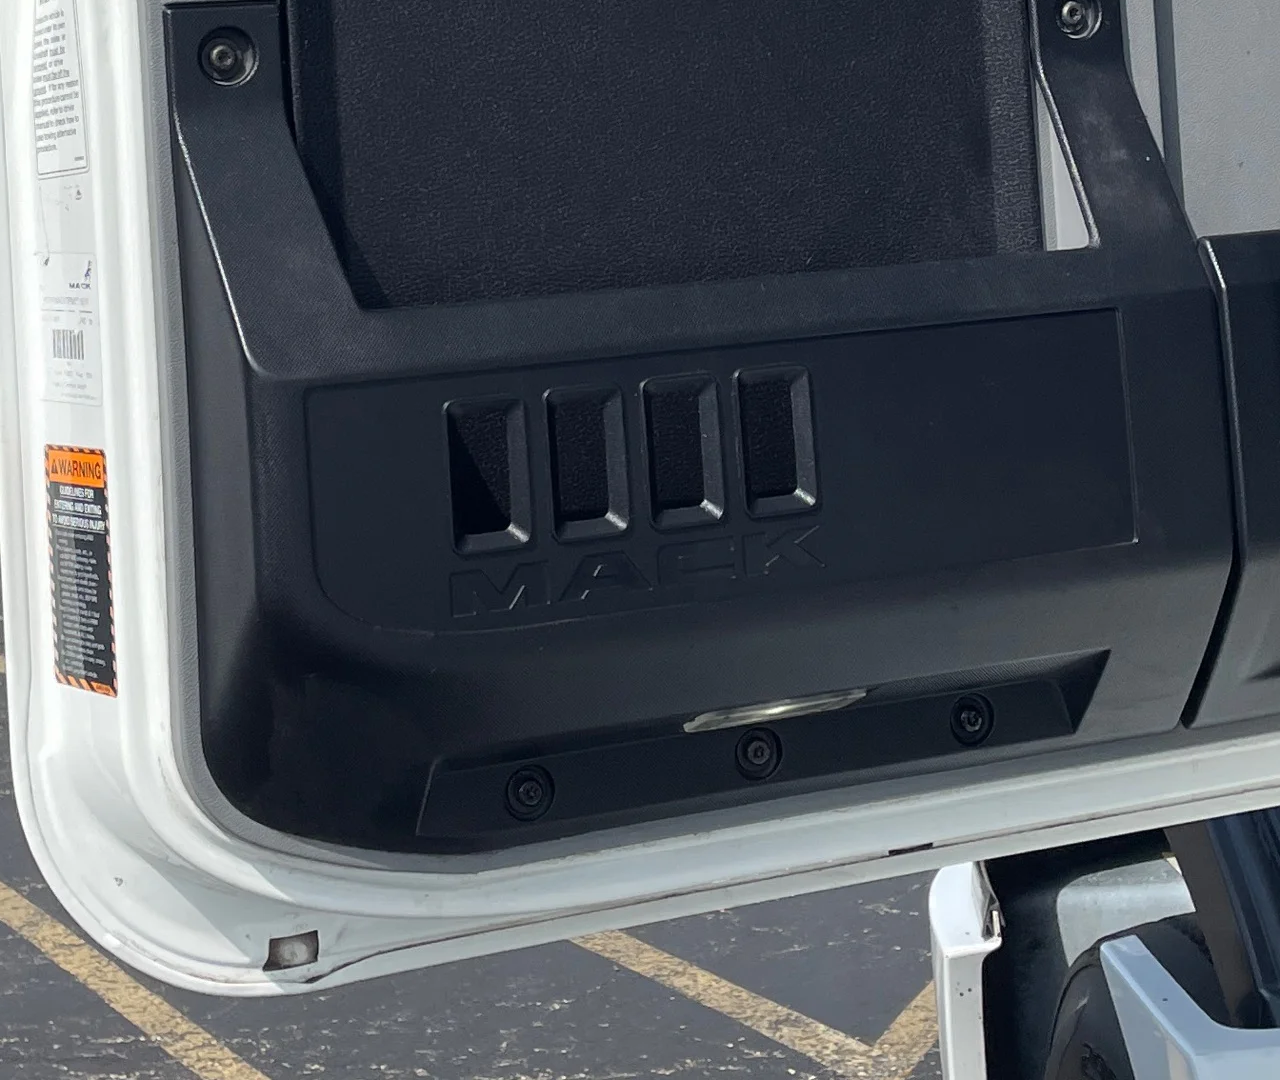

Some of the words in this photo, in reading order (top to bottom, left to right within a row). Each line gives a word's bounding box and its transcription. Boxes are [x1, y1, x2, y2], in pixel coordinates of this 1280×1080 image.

[69, 282, 92, 290] MACK
[59, 459, 102, 480] WARNING
[449, 524, 826, 618] MACK
